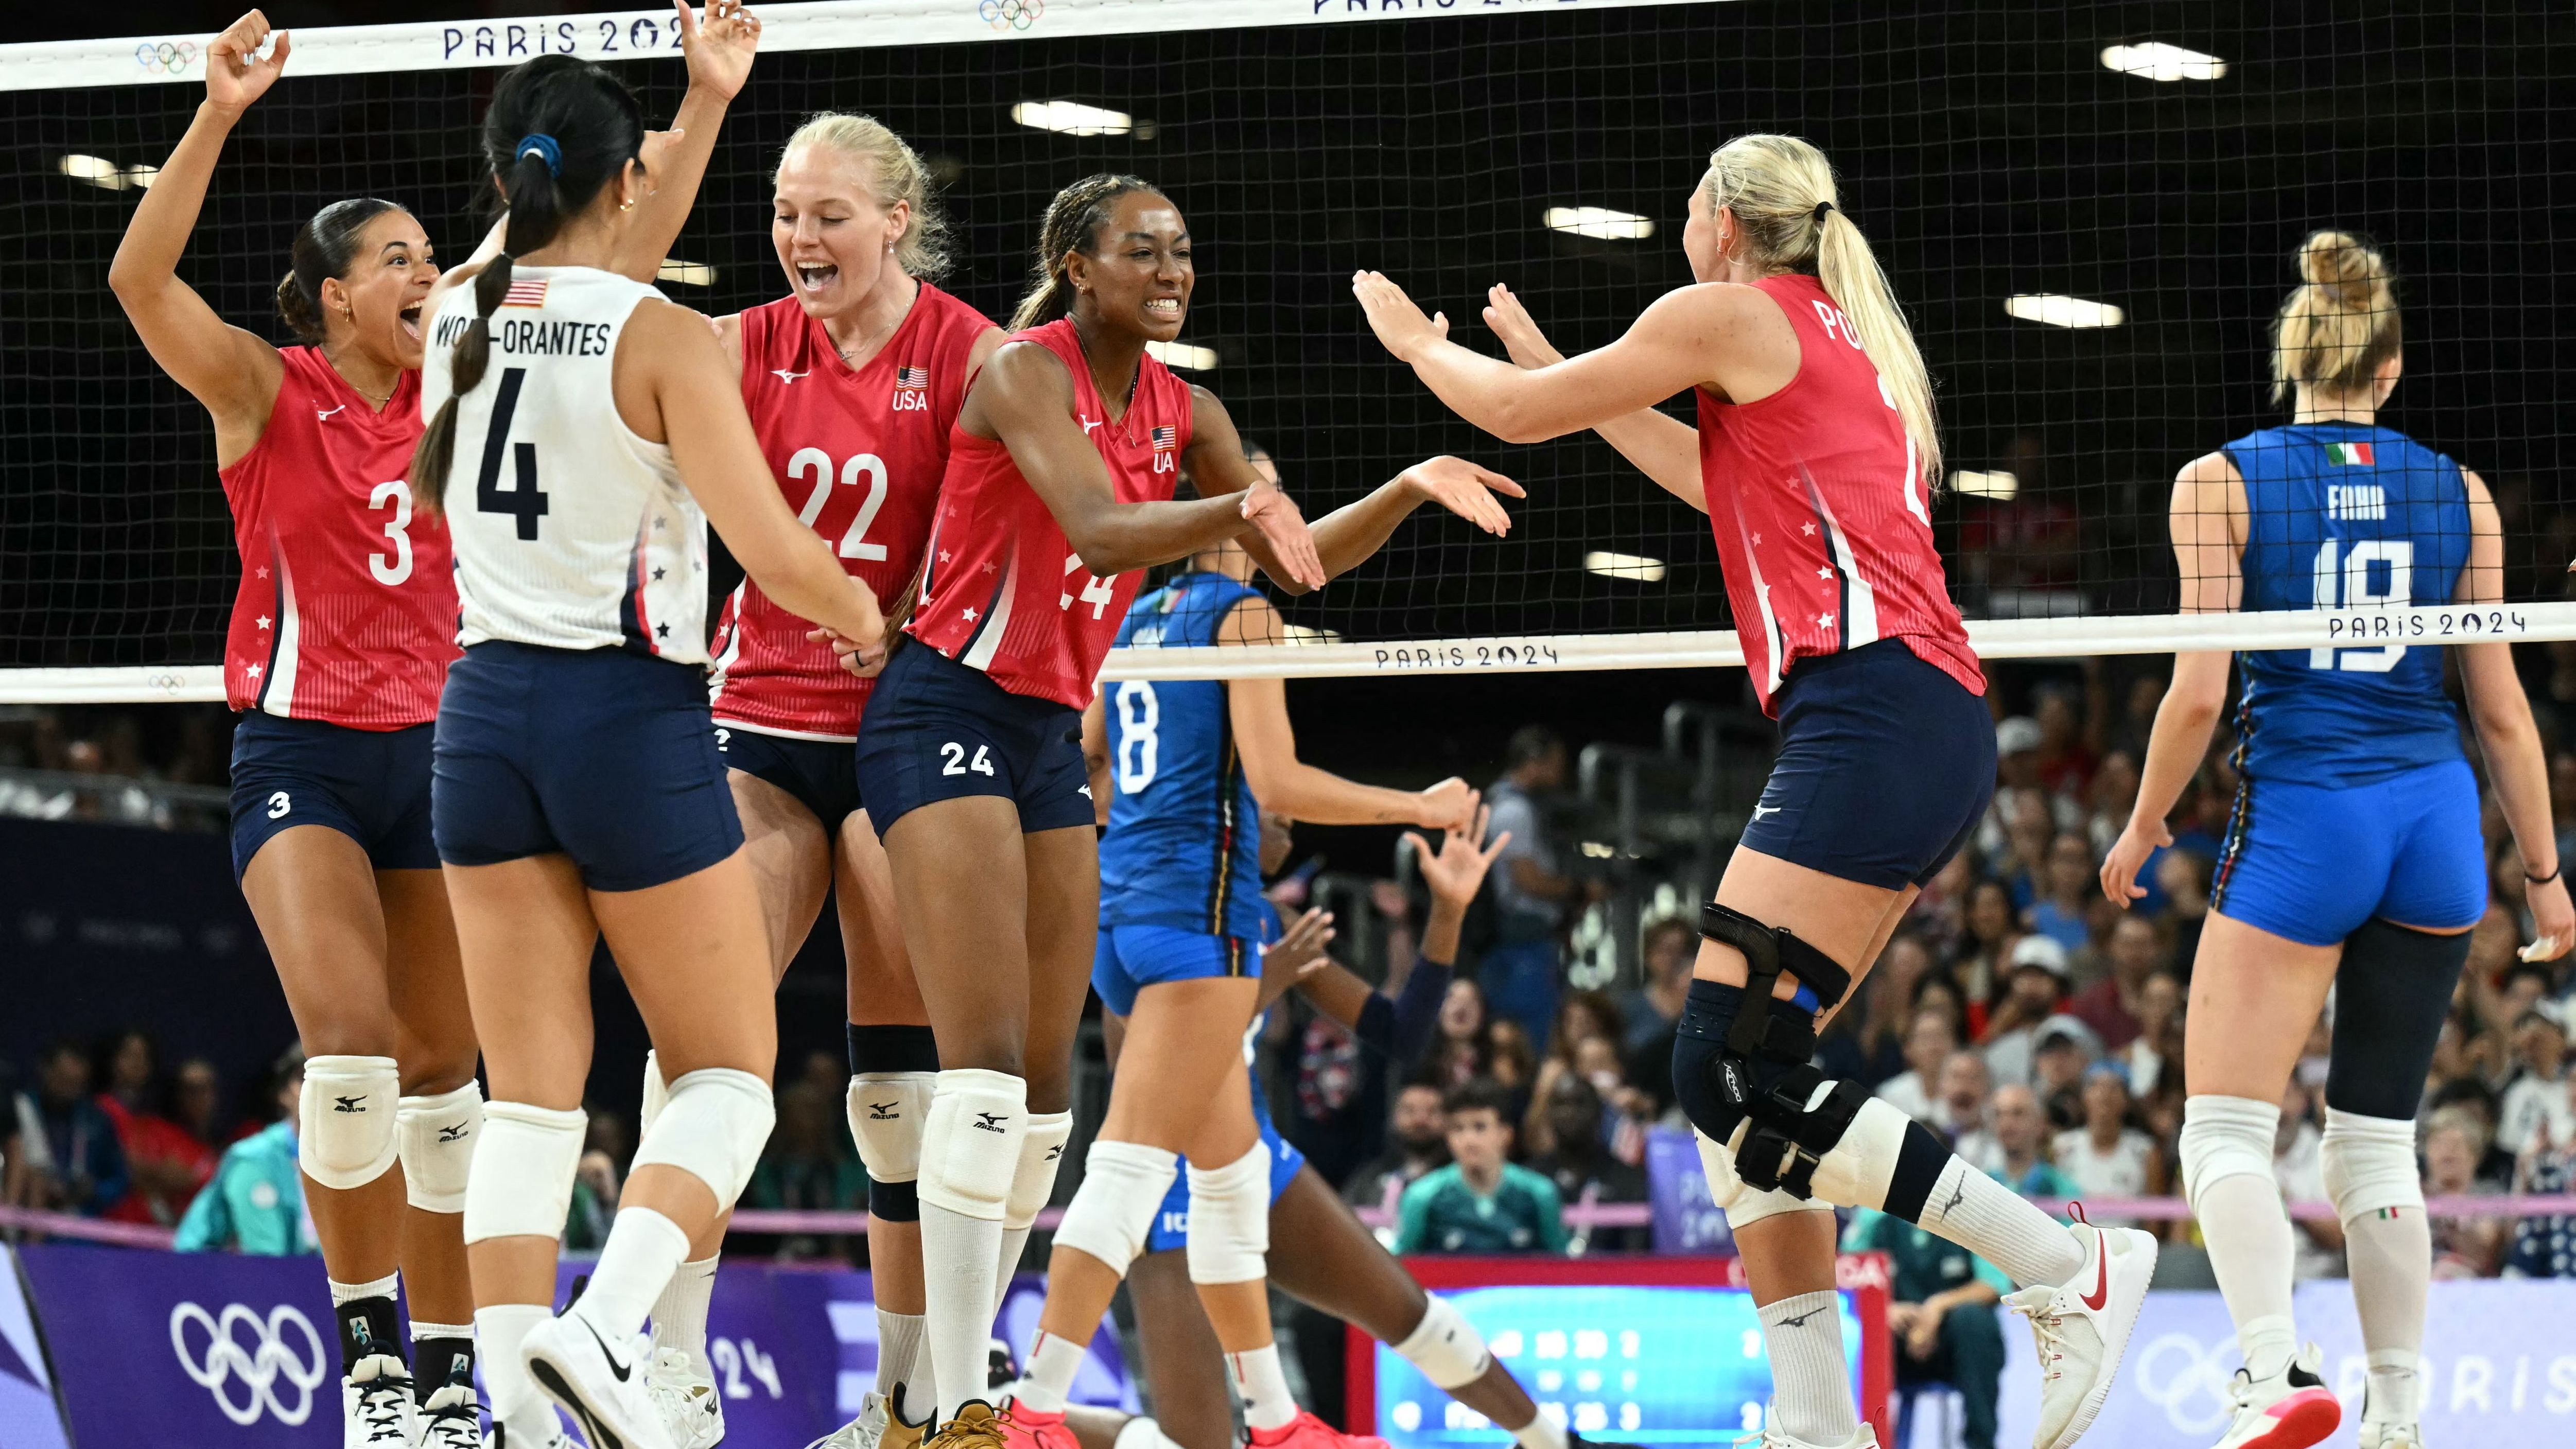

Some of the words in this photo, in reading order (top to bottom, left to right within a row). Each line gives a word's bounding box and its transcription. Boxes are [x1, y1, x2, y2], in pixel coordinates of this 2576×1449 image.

[599, 15, 704, 51] 202
[437, 314, 610, 356] WO-ORANTES
[892, 390, 928, 411] USA
[477, 368, 548, 540] 4
[1153, 451, 1175, 474] UA
[787, 446, 888, 562] 22
[368, 479, 413, 586] 3
[2309, 537, 2413, 672] 19
[2439, 612, 2526, 636] 2024
[1477, 645, 1558, 666] 2024
[1115, 679, 1159, 795] 8
[940, 741, 995, 777] 24
[267, 791, 291, 819] 3
[710, 1337, 784, 1400] 24
